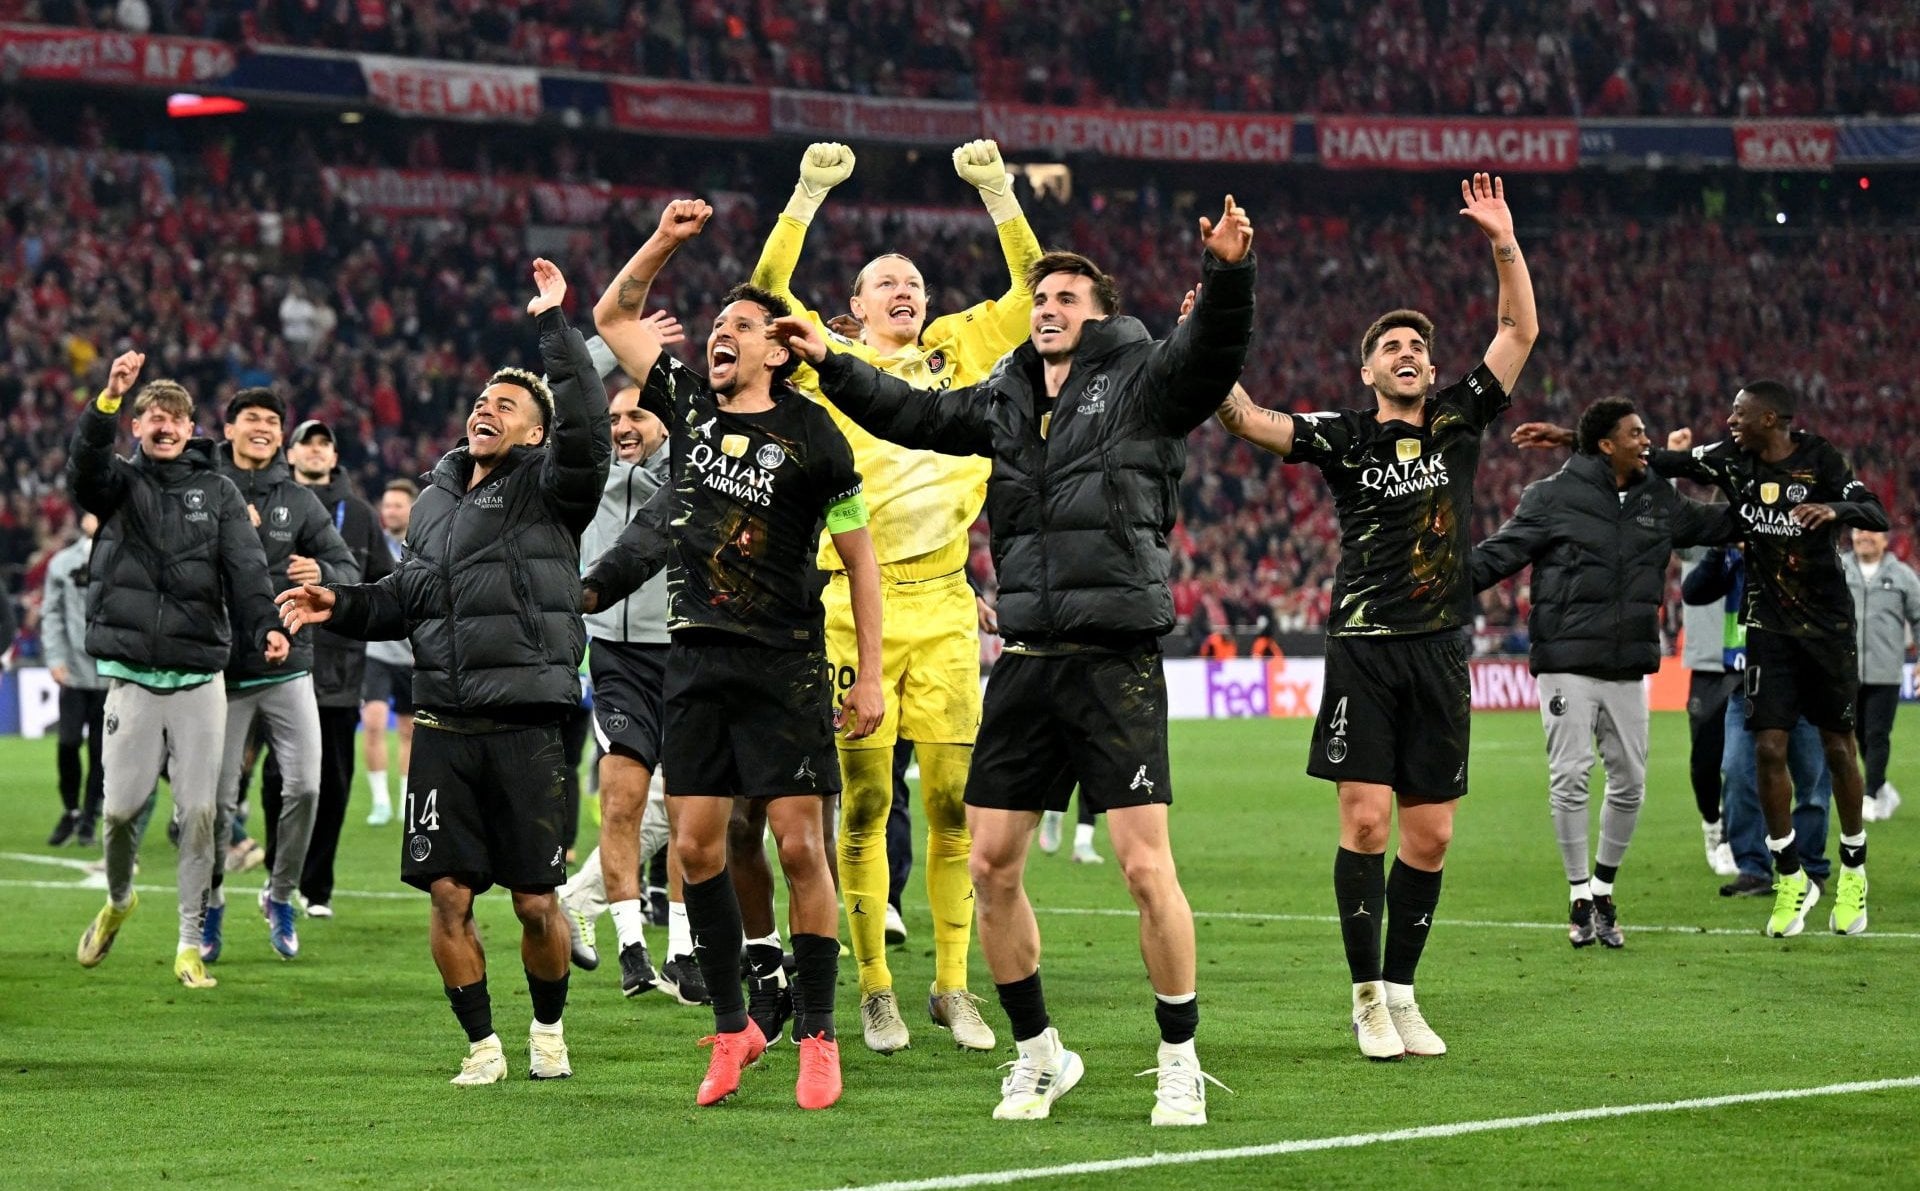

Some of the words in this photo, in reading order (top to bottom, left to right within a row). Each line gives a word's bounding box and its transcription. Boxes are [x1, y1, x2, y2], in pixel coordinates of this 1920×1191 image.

[982, 104, 1289, 160] NIEDERWEIDBACH
[1322, 126, 1572, 162] HAVELMACHT
[1742, 138, 1830, 162] SAW
[688, 443, 775, 493] QATAR
[1361, 452, 1446, 490] QATAR
[1384, 471, 1449, 498] AIRWAYS
[474, 496, 503, 506] QATAR
[703, 473, 771, 507] AIRWAYS
[1752, 522, 1802, 537] AIRWAYS
[1207, 660, 1314, 718] FedEx
[1330, 696, 1348, 736] 4
[408, 788, 440, 834] 14
